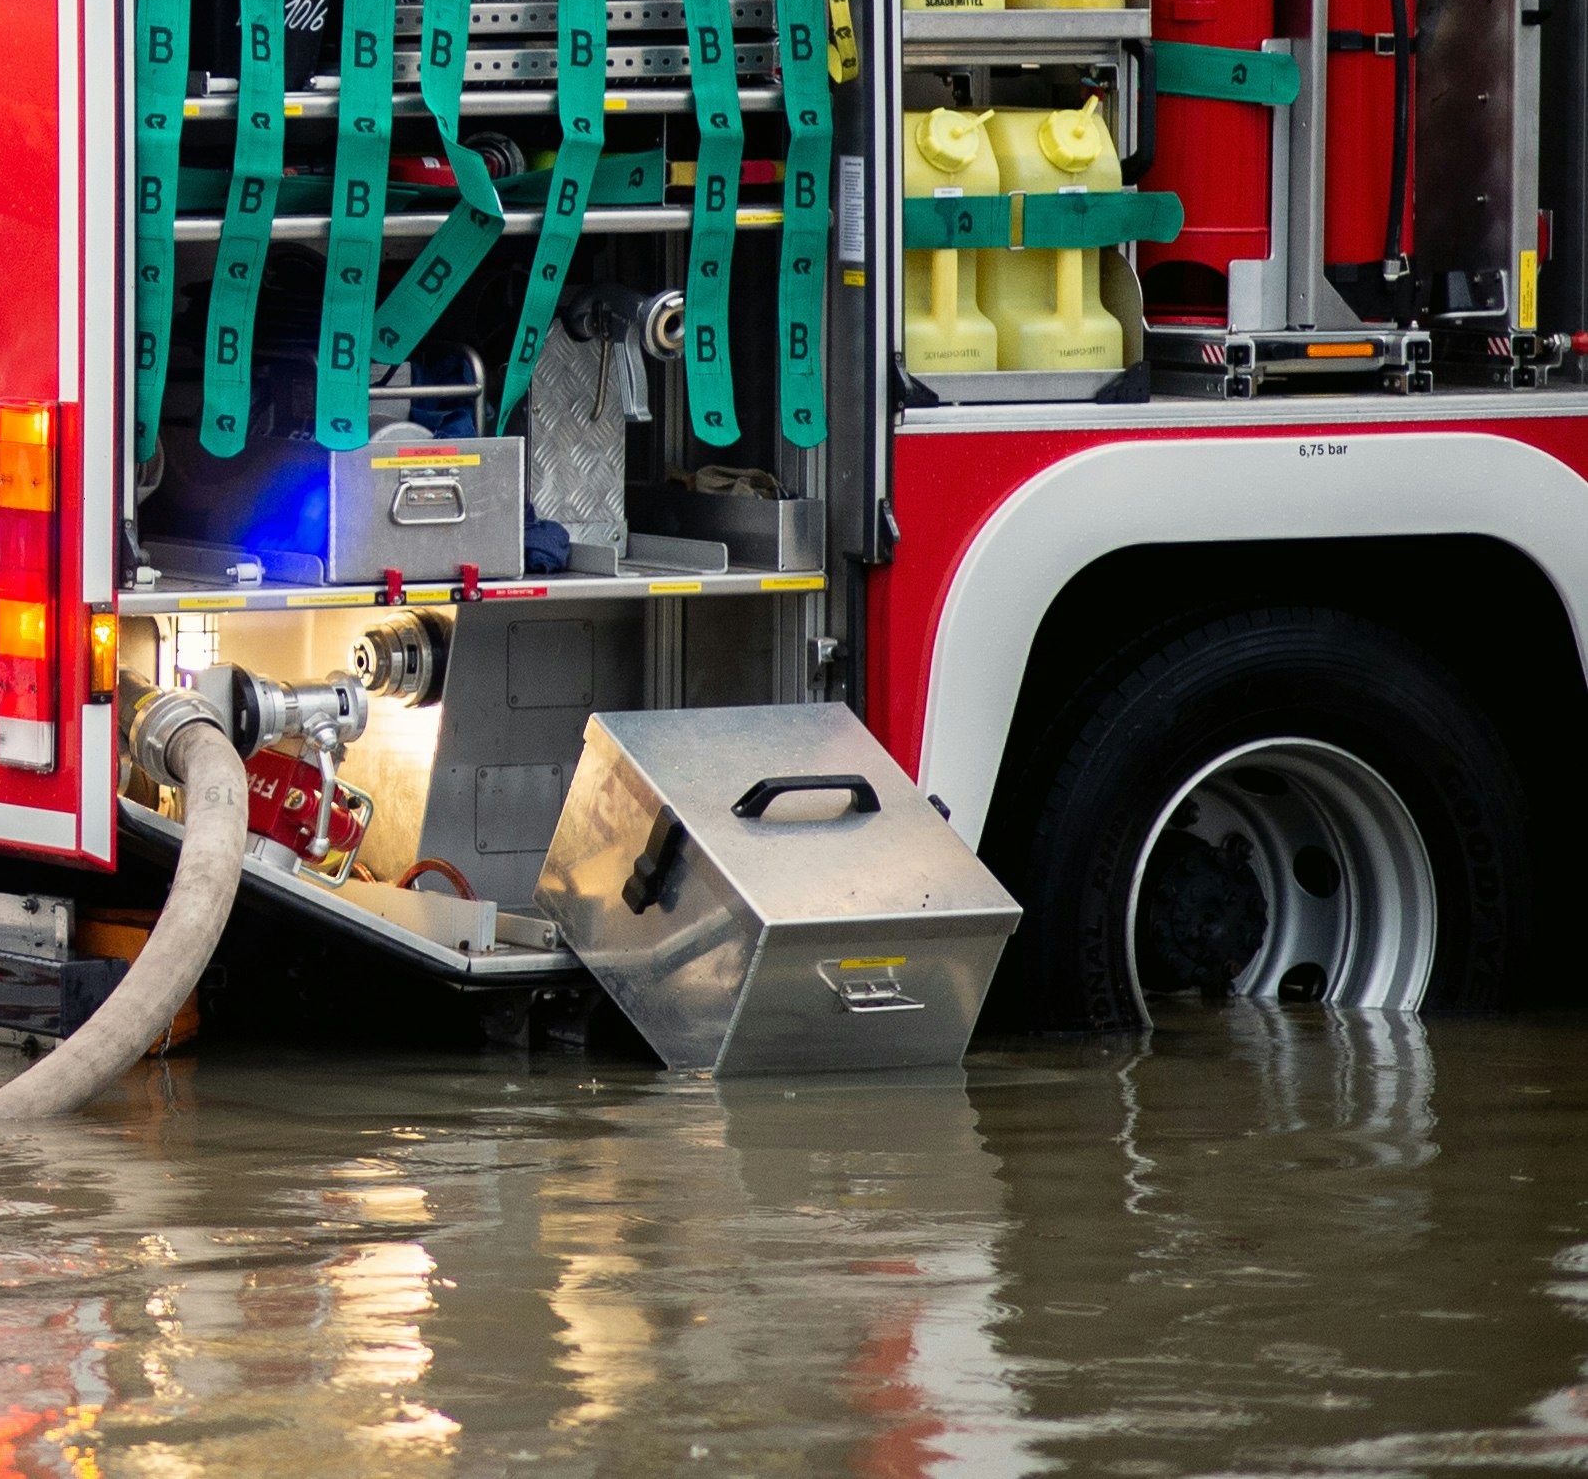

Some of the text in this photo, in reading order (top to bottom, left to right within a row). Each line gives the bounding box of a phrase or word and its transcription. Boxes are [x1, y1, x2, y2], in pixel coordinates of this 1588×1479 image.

[149, 26, 173, 64] B
[251, 23, 271, 61] B
[354, 30, 377, 68] B
[430, 28, 453, 68] B
[570, 29, 593, 67] B
[698, 26, 722, 64] B
[790, 23, 814, 61] B
[138, 176, 162, 215] B
[238, 176, 266, 214] B
[345, 179, 371, 218] B
[556, 178, 579, 217] B
[706, 174, 726, 212] B
[795, 170, 816, 209] B
[417, 254, 451, 295] B
[217, 326, 239, 365] B
[331, 332, 356, 370] B
[519, 325, 539, 365] B
[696, 325, 717, 363] B
[789, 322, 809, 360] B
[1299, 443, 1348, 458] 6,75 bar
